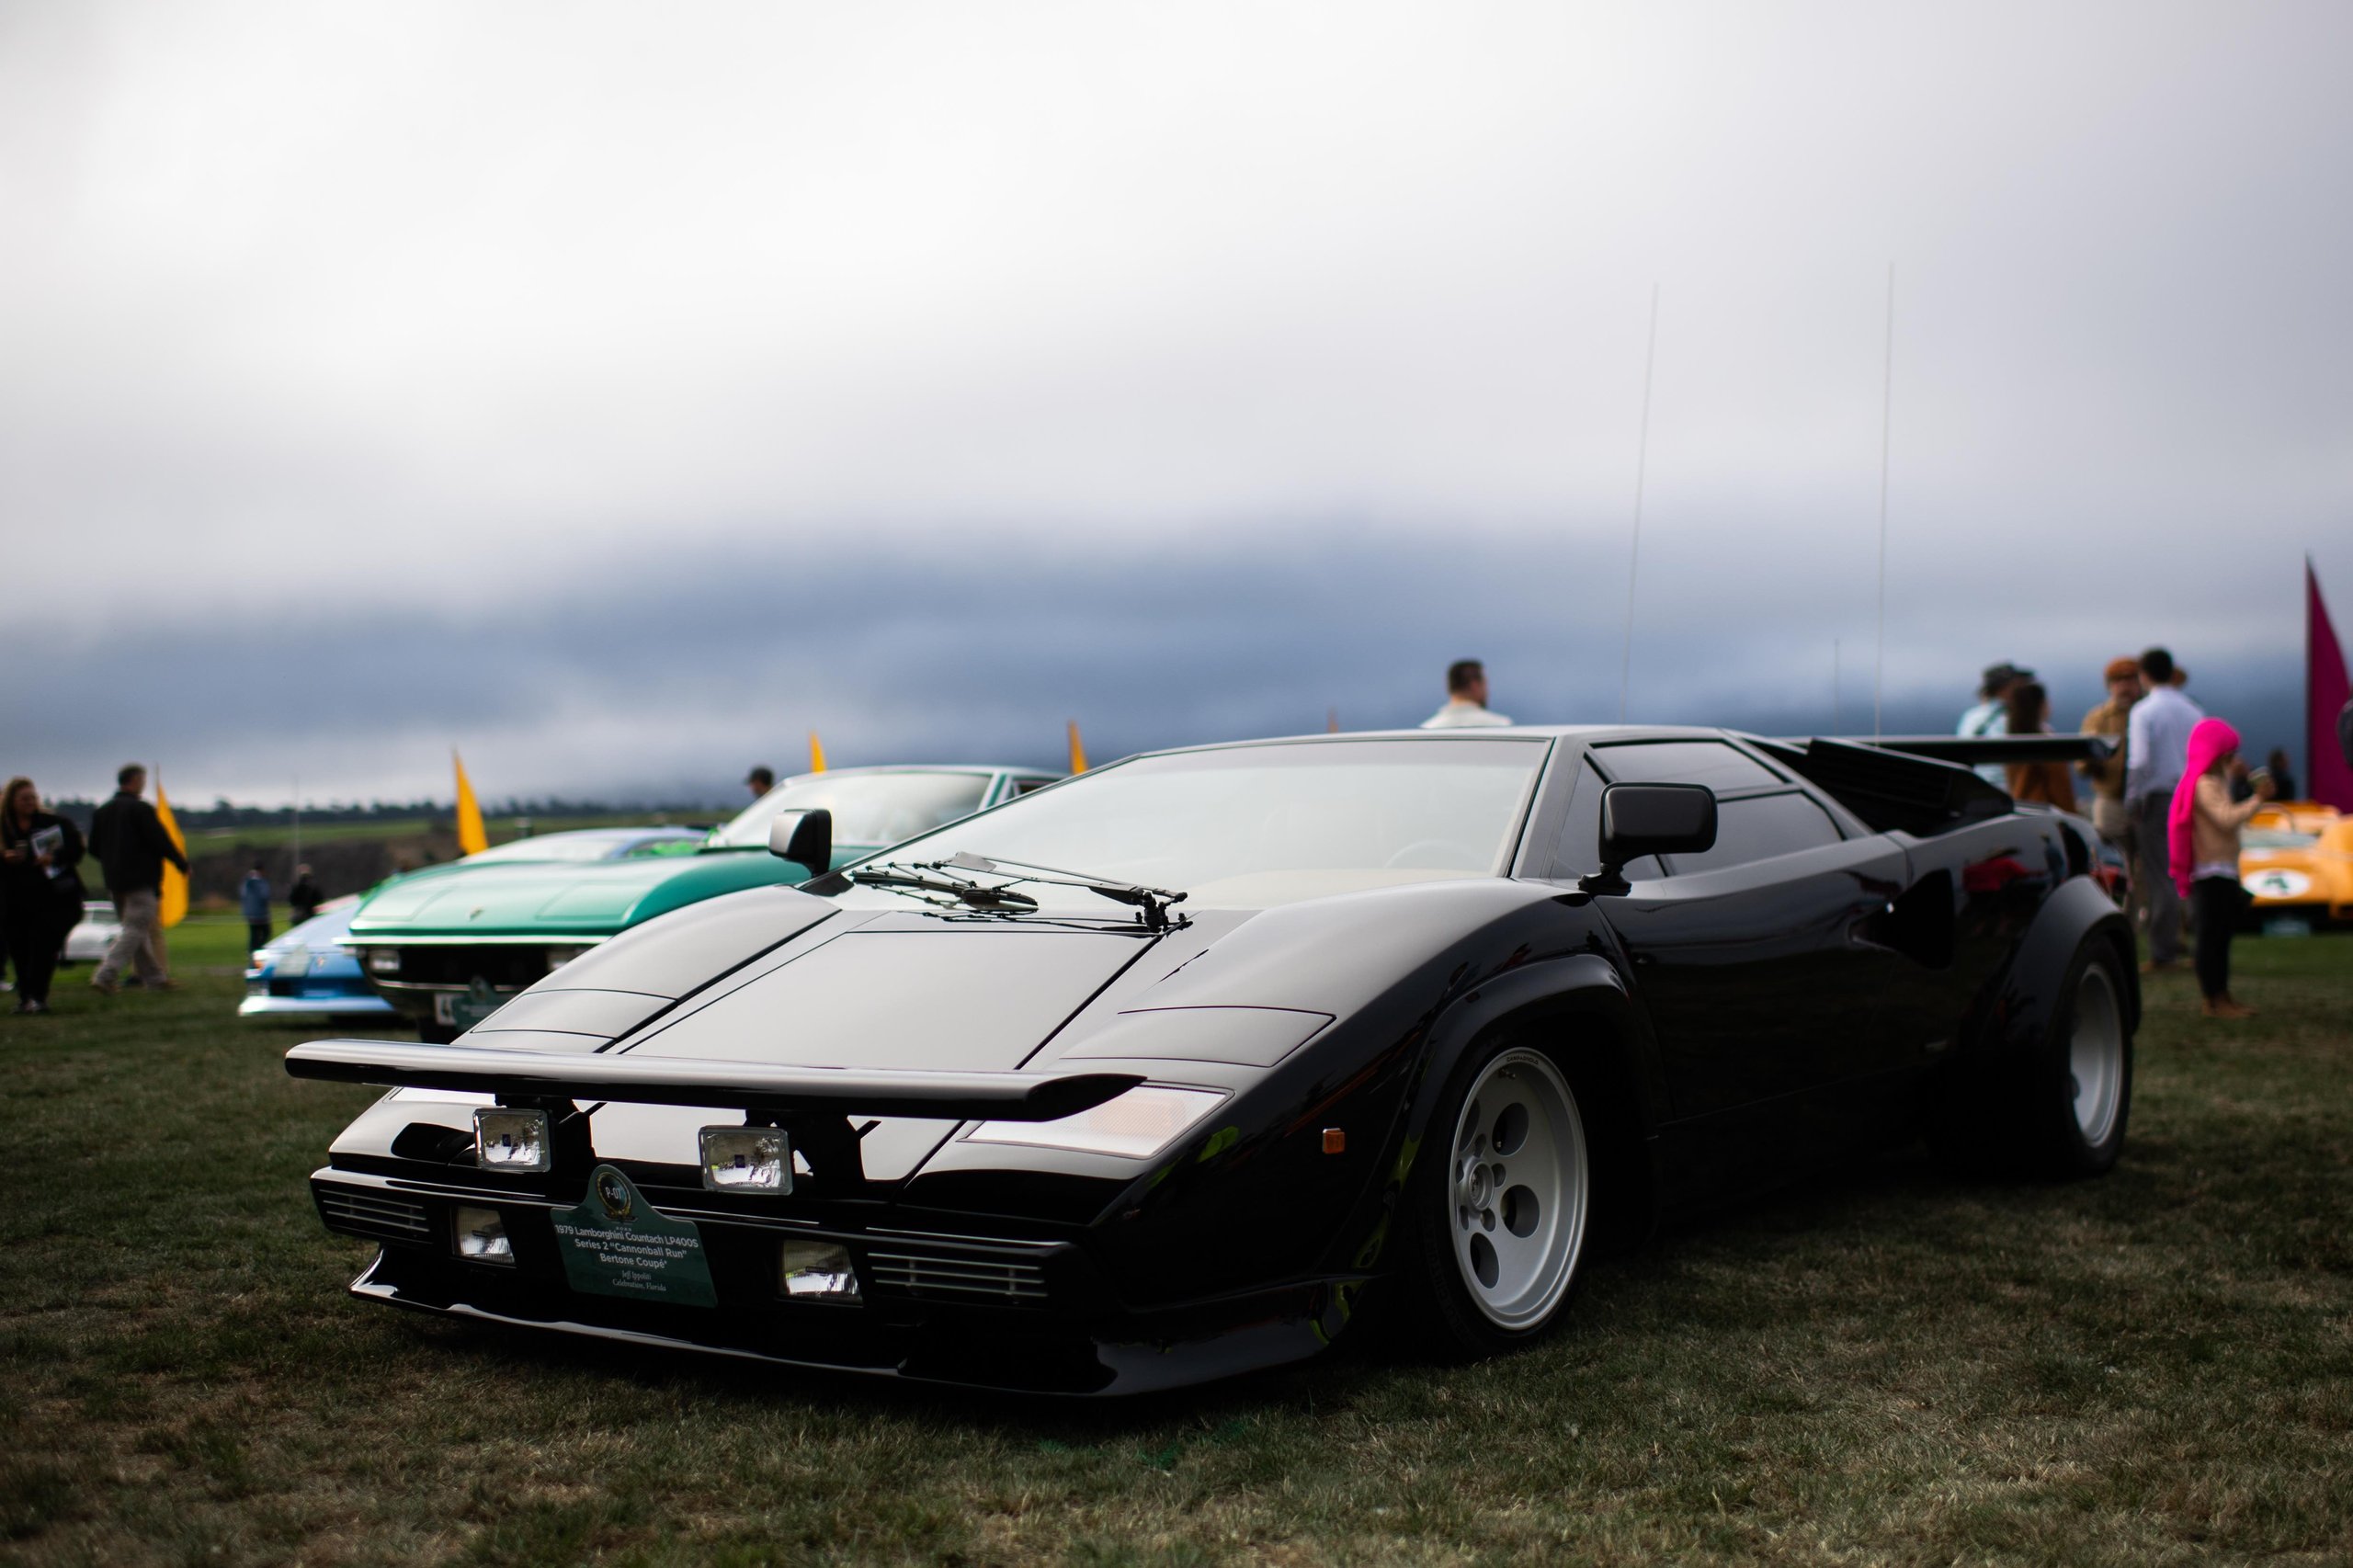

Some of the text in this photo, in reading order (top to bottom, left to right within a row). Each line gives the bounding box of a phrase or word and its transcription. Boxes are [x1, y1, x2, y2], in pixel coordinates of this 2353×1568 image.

[554, 1224, 574, 1234] 1979
[574, 1226, 625, 1241] Lamborghini
[625, 1232, 665, 1244] Countach
[664, 1235, 699, 1248] LP400S
[574, 1238, 601, 1250] Series
[602, 1241, 608, 1251] 2
[599, 1253, 634, 1266] Bertone
